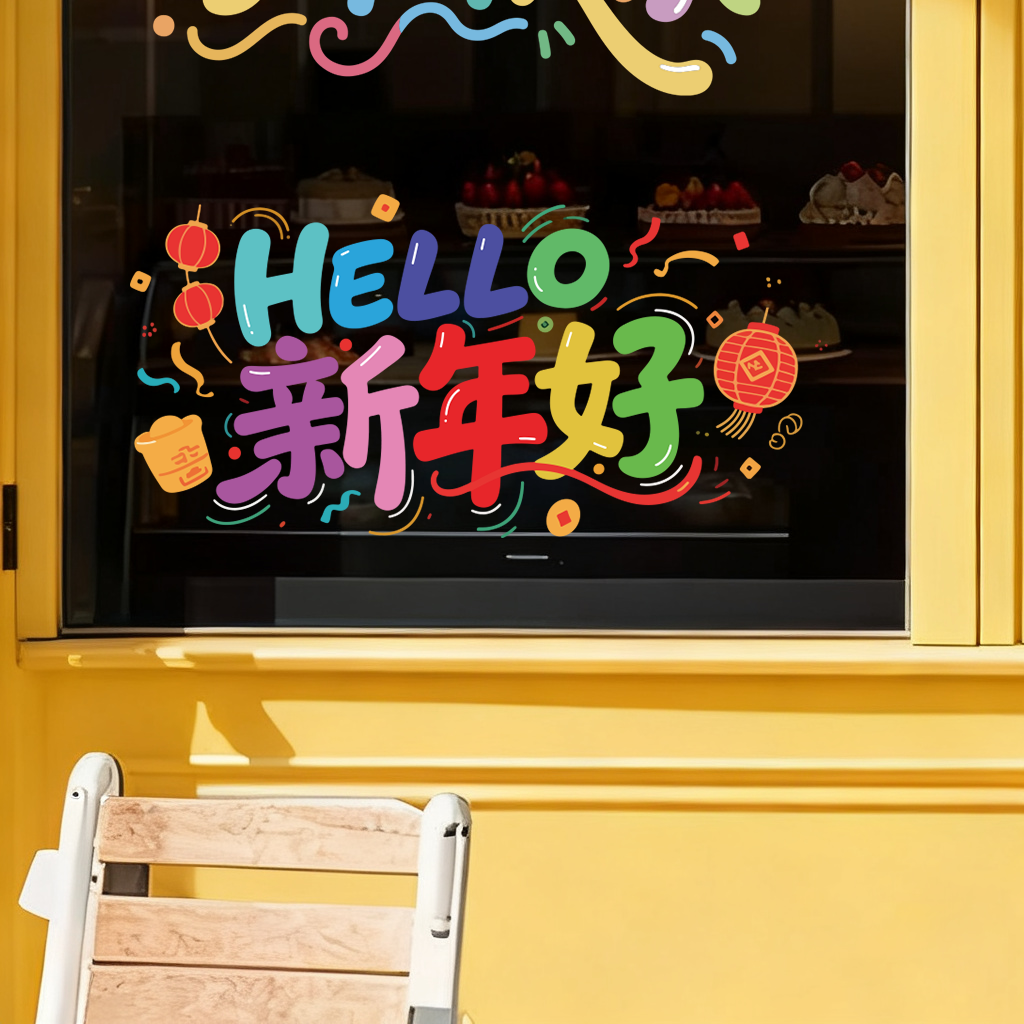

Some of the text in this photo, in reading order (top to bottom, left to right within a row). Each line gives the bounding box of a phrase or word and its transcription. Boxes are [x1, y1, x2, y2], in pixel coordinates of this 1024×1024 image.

[234, 222, 610, 347] HELLO
[215, 316, 705, 512] 新年好
